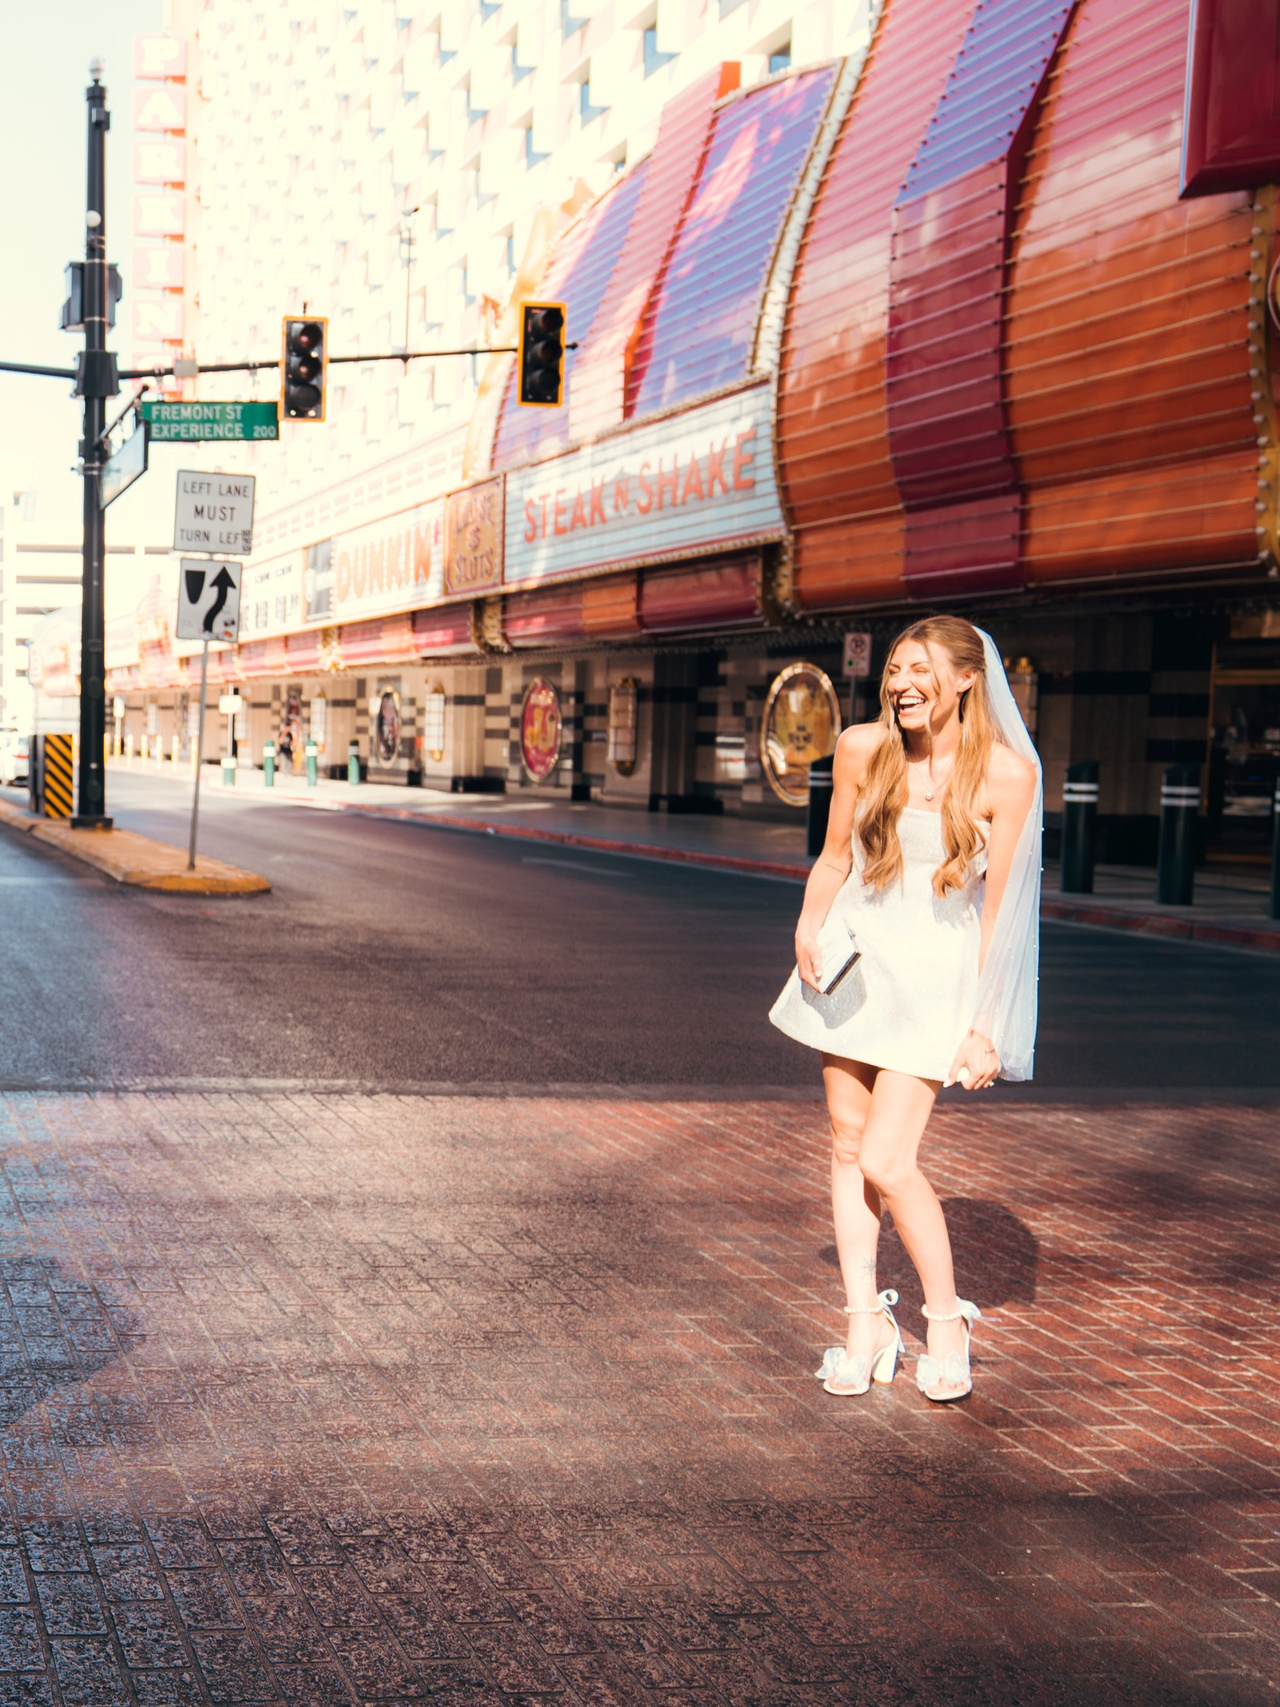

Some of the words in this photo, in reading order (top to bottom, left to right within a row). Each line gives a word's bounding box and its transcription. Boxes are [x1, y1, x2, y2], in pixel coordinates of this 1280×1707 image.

[151, 405, 223, 420] FREMONT
[226, 405, 243, 420] ST
[151, 423, 244, 438] EXPERIENCE
[253, 425, 277, 438] 200
[183, 481, 211, 495] LEFT
[218, 484, 249, 499] LANE
[524, 474, 608, 543] STEAK
[614, 480, 630, 513] N
[636, 427, 757, 515] SHAKE
[194, 504, 236, 522] MUST
[180, 528, 210, 542] TURN
[219, 530, 241, 545] LEF
